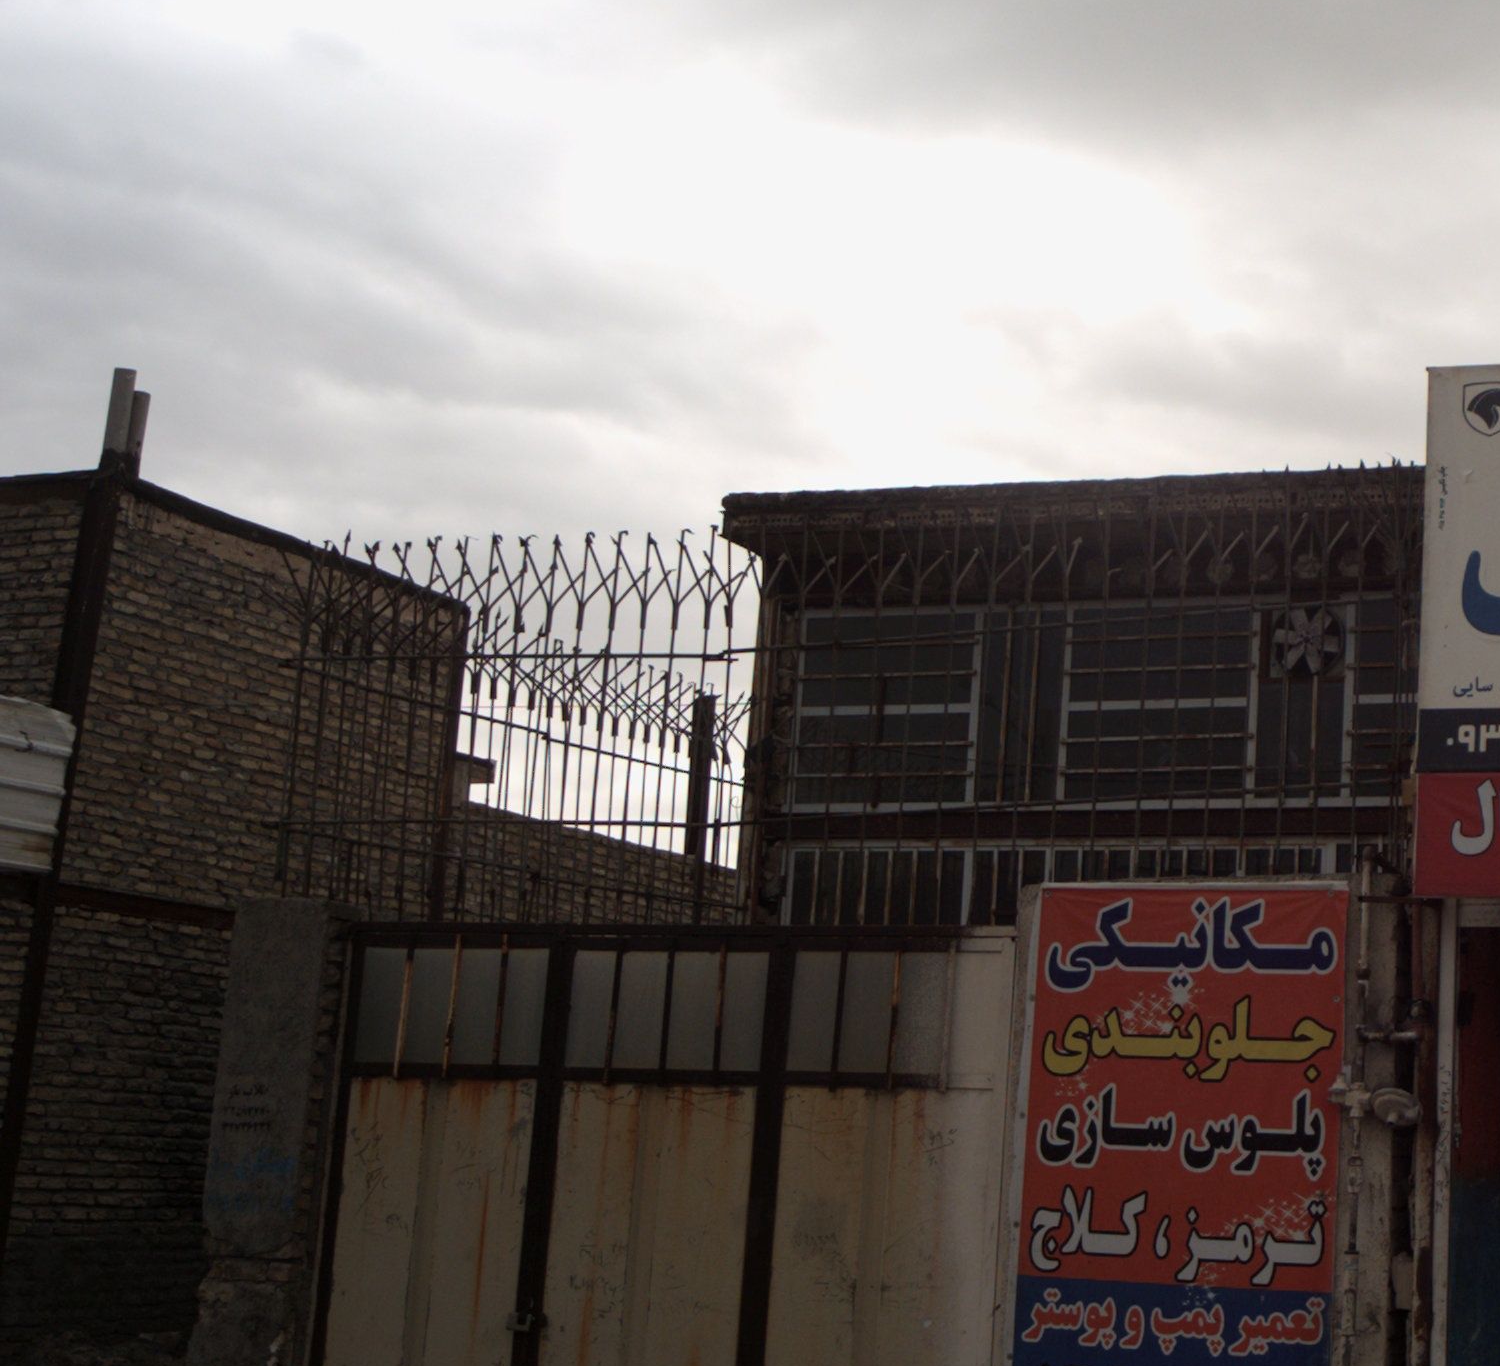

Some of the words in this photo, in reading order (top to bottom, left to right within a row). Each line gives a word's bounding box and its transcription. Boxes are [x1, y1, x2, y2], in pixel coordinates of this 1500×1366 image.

[1452, 675, 1494, 697] سایی
[1046, 896, 1337, 993] مکانیکی
[1042, 995, 1337, 1083] جلوبندی
[1037, 1082, 1177, 1168] سازی
[1182, 1088, 1326, 1181] پلوس
[1029, 1183, 1148, 1273] کلاج
[1120, 1305, 1146, 1350] و
[1151, 1303, 1225, 1356] پمپ
[1228, 1297, 1326, 1356] تعمیر
